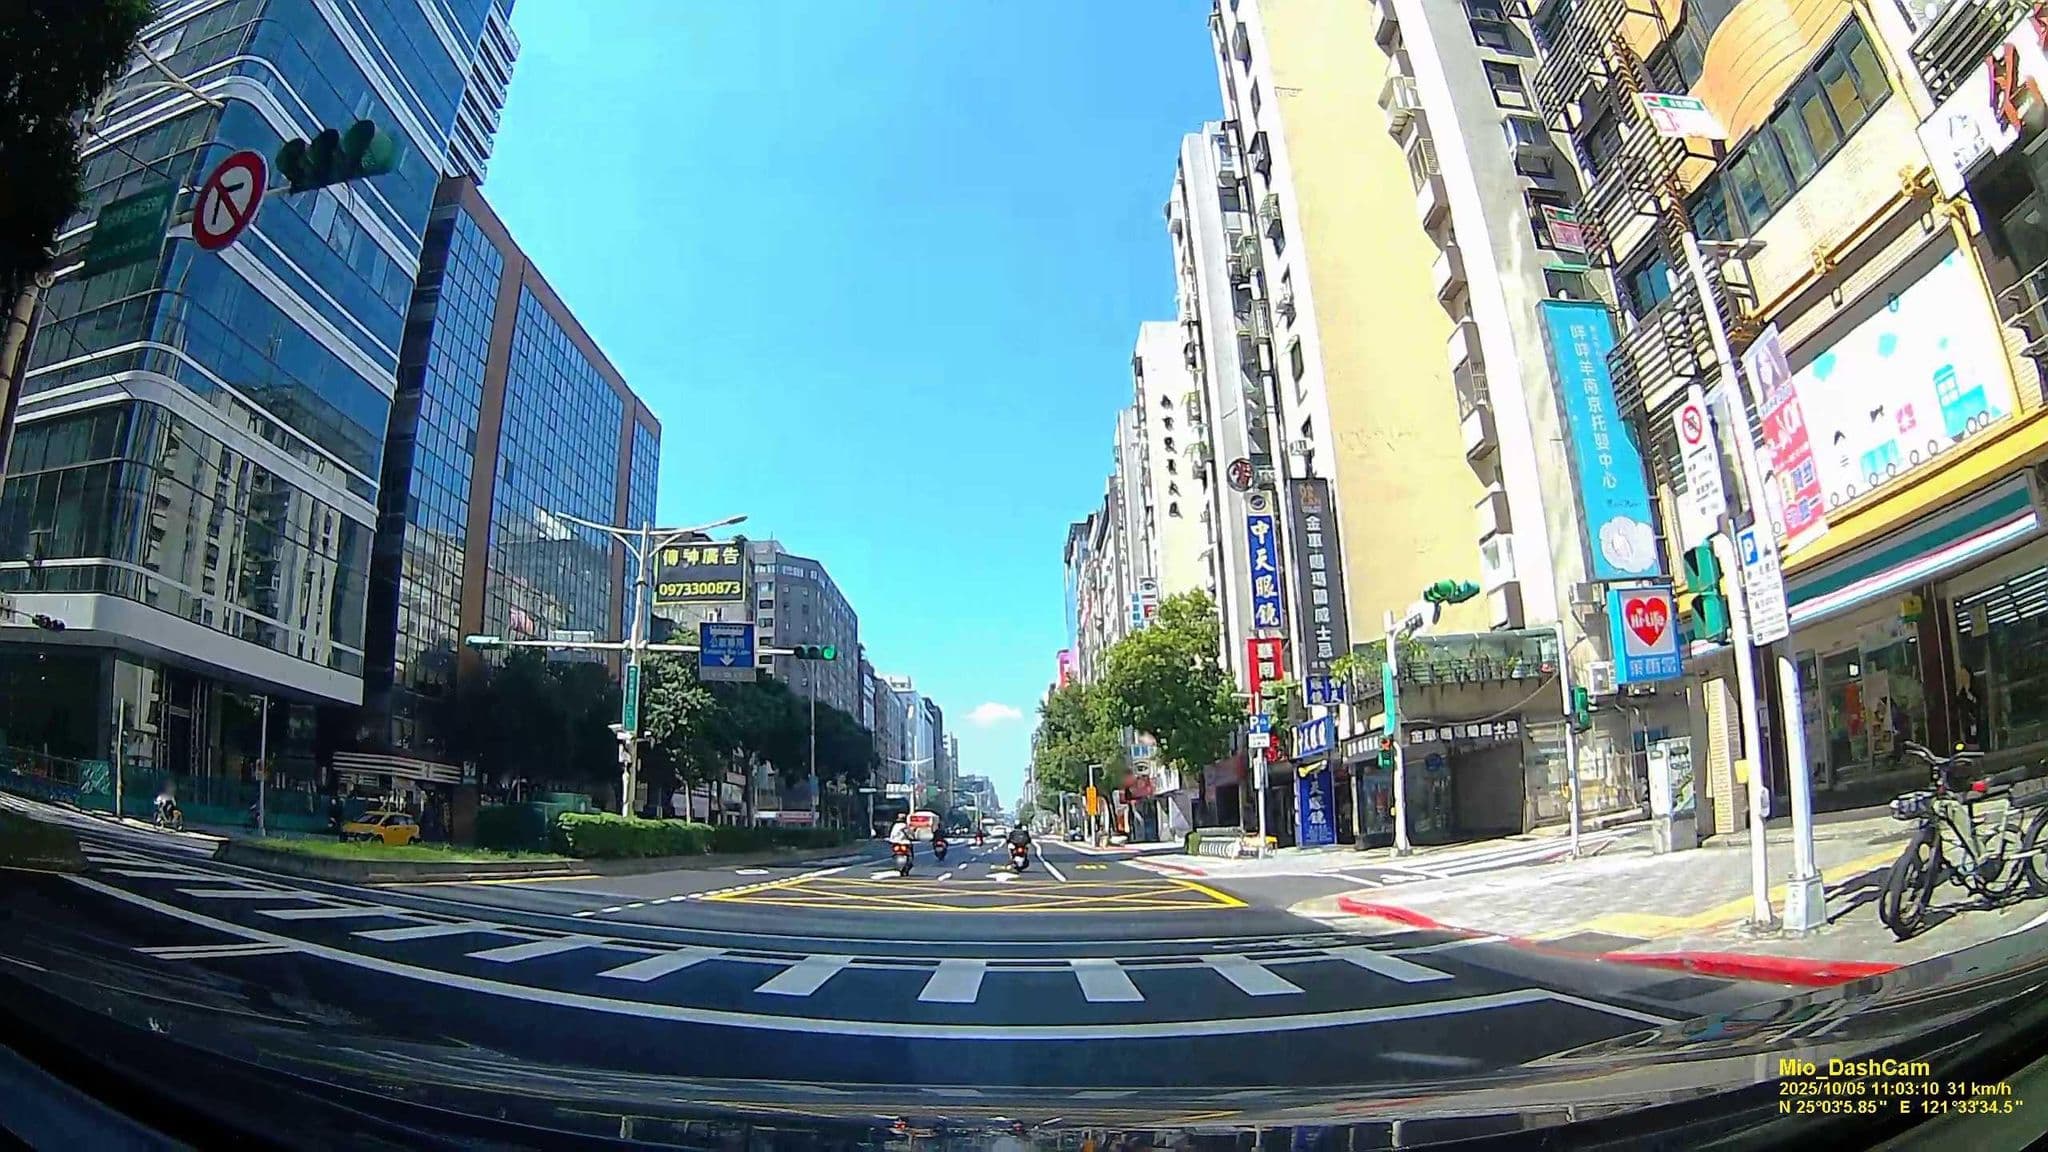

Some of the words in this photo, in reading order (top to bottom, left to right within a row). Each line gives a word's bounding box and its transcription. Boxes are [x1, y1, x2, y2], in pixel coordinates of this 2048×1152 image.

[659, 581, 741, 596] 0973300873
[1250, 520, 1279, 626] 中天眼鏡
